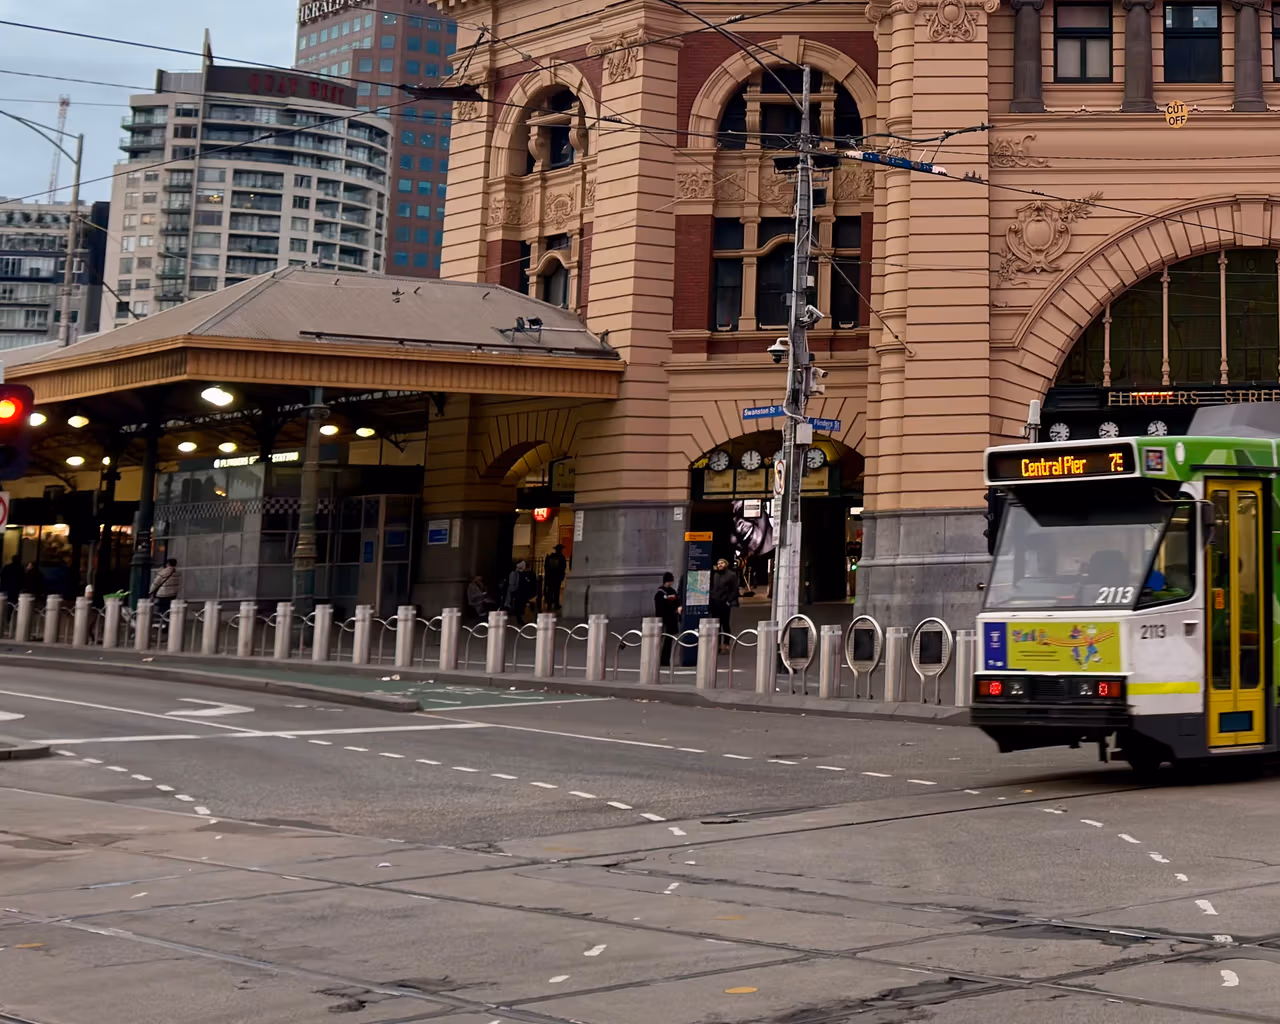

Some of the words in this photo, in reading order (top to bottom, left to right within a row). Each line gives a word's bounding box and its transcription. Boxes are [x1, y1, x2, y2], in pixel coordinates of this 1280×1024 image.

[1166, 104, 1185, 115] CUT
[1168, 115, 1186, 125] OFF
[1107, 390, 1200, 406] FLINDERS
[743, 407, 769, 416] Swanston
[769, 406, 776, 414] St
[813, 419, 833, 428] Flinders
[1021, 456, 1063, 477] Central
[1063, 455, 1087, 475] Pier
[1108, 452, 1124, 472] 75
[1095, 586, 1134, 604] 2113
[1141, 625, 1167, 640] 2113
